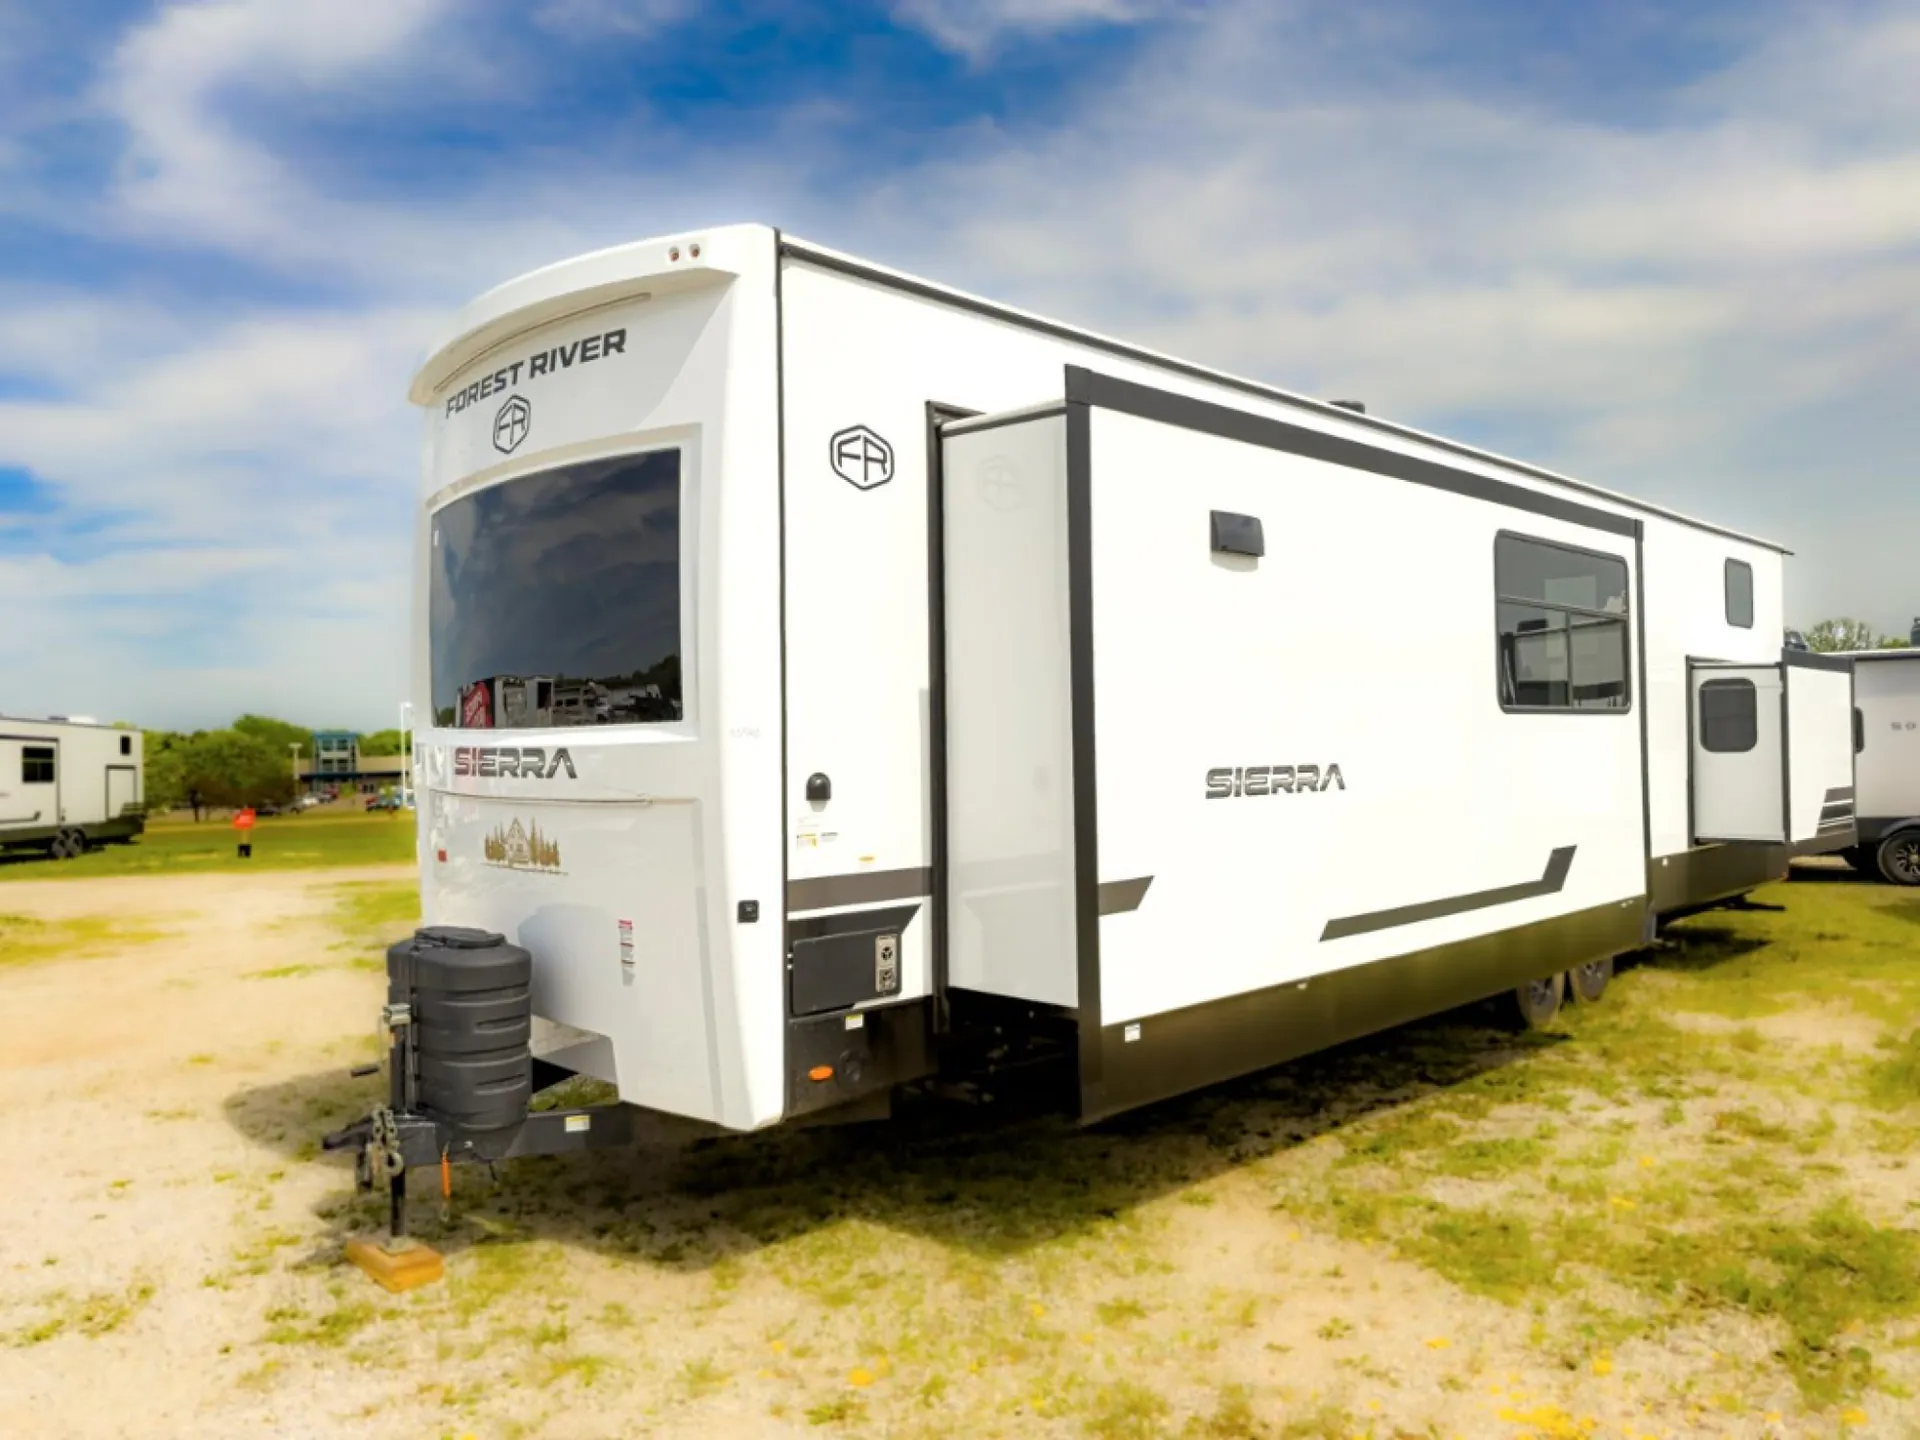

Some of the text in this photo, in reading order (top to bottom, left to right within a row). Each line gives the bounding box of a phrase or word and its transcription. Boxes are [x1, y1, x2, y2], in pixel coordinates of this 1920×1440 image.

[446, 328, 627, 419] FOREST RIVER
[455, 747, 578, 779] SIERRA
[1205, 763, 1346, 799] SIERRA
